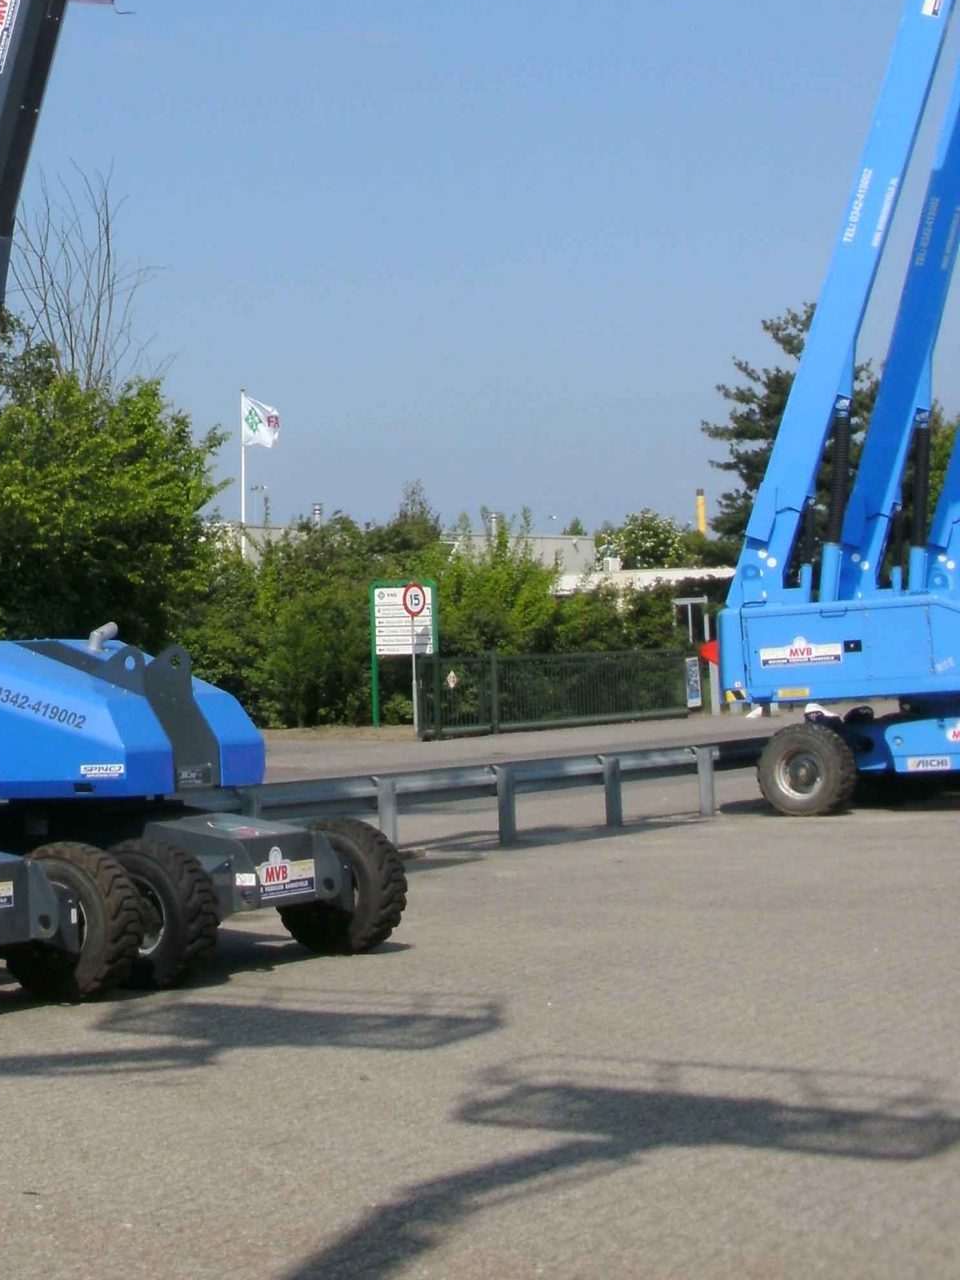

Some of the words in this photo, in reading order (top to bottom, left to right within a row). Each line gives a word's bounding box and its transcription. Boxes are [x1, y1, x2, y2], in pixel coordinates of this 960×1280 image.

[409, 594, 421, 606] 15
[789, 647, 812, 657] MVB
[265, 865, 288, 883] MVB
